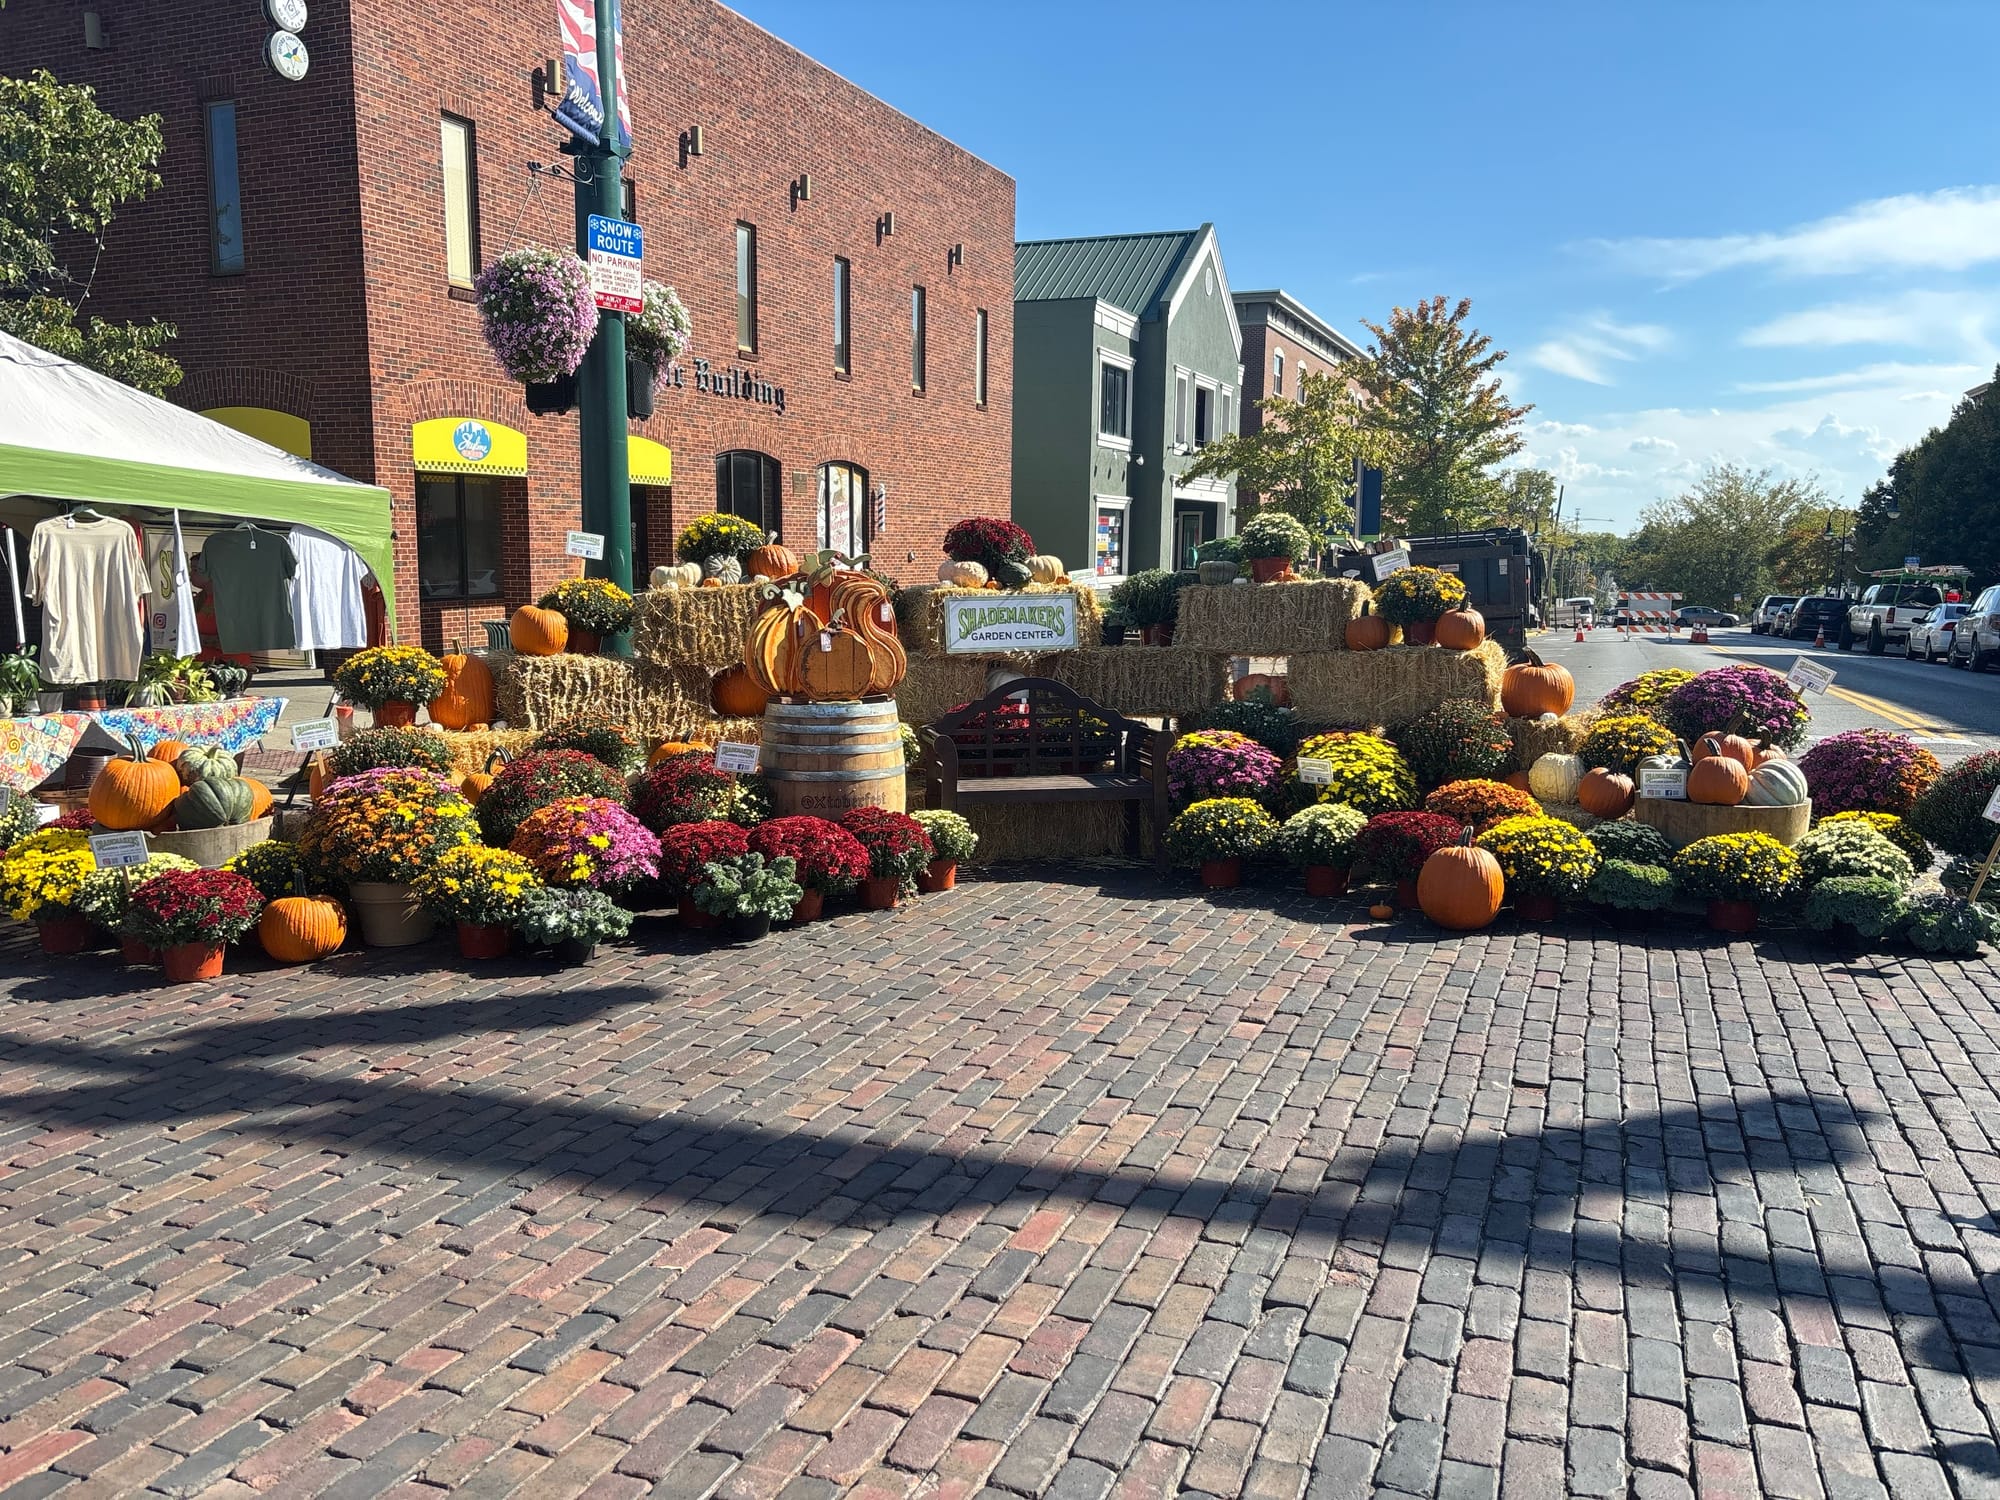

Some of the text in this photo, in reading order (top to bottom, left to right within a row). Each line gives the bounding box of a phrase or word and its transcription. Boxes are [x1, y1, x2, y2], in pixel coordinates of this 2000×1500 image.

[599, 220, 632, 238] SNOW
[598, 235, 635, 254] ROUTE
[591, 253, 641, 272] NO PARKING
[693, 358, 786, 416] Building
[957, 605, 1066, 640] SHADEMAKERS
[971, 630, 1054, 641] GARDEN CENTER
